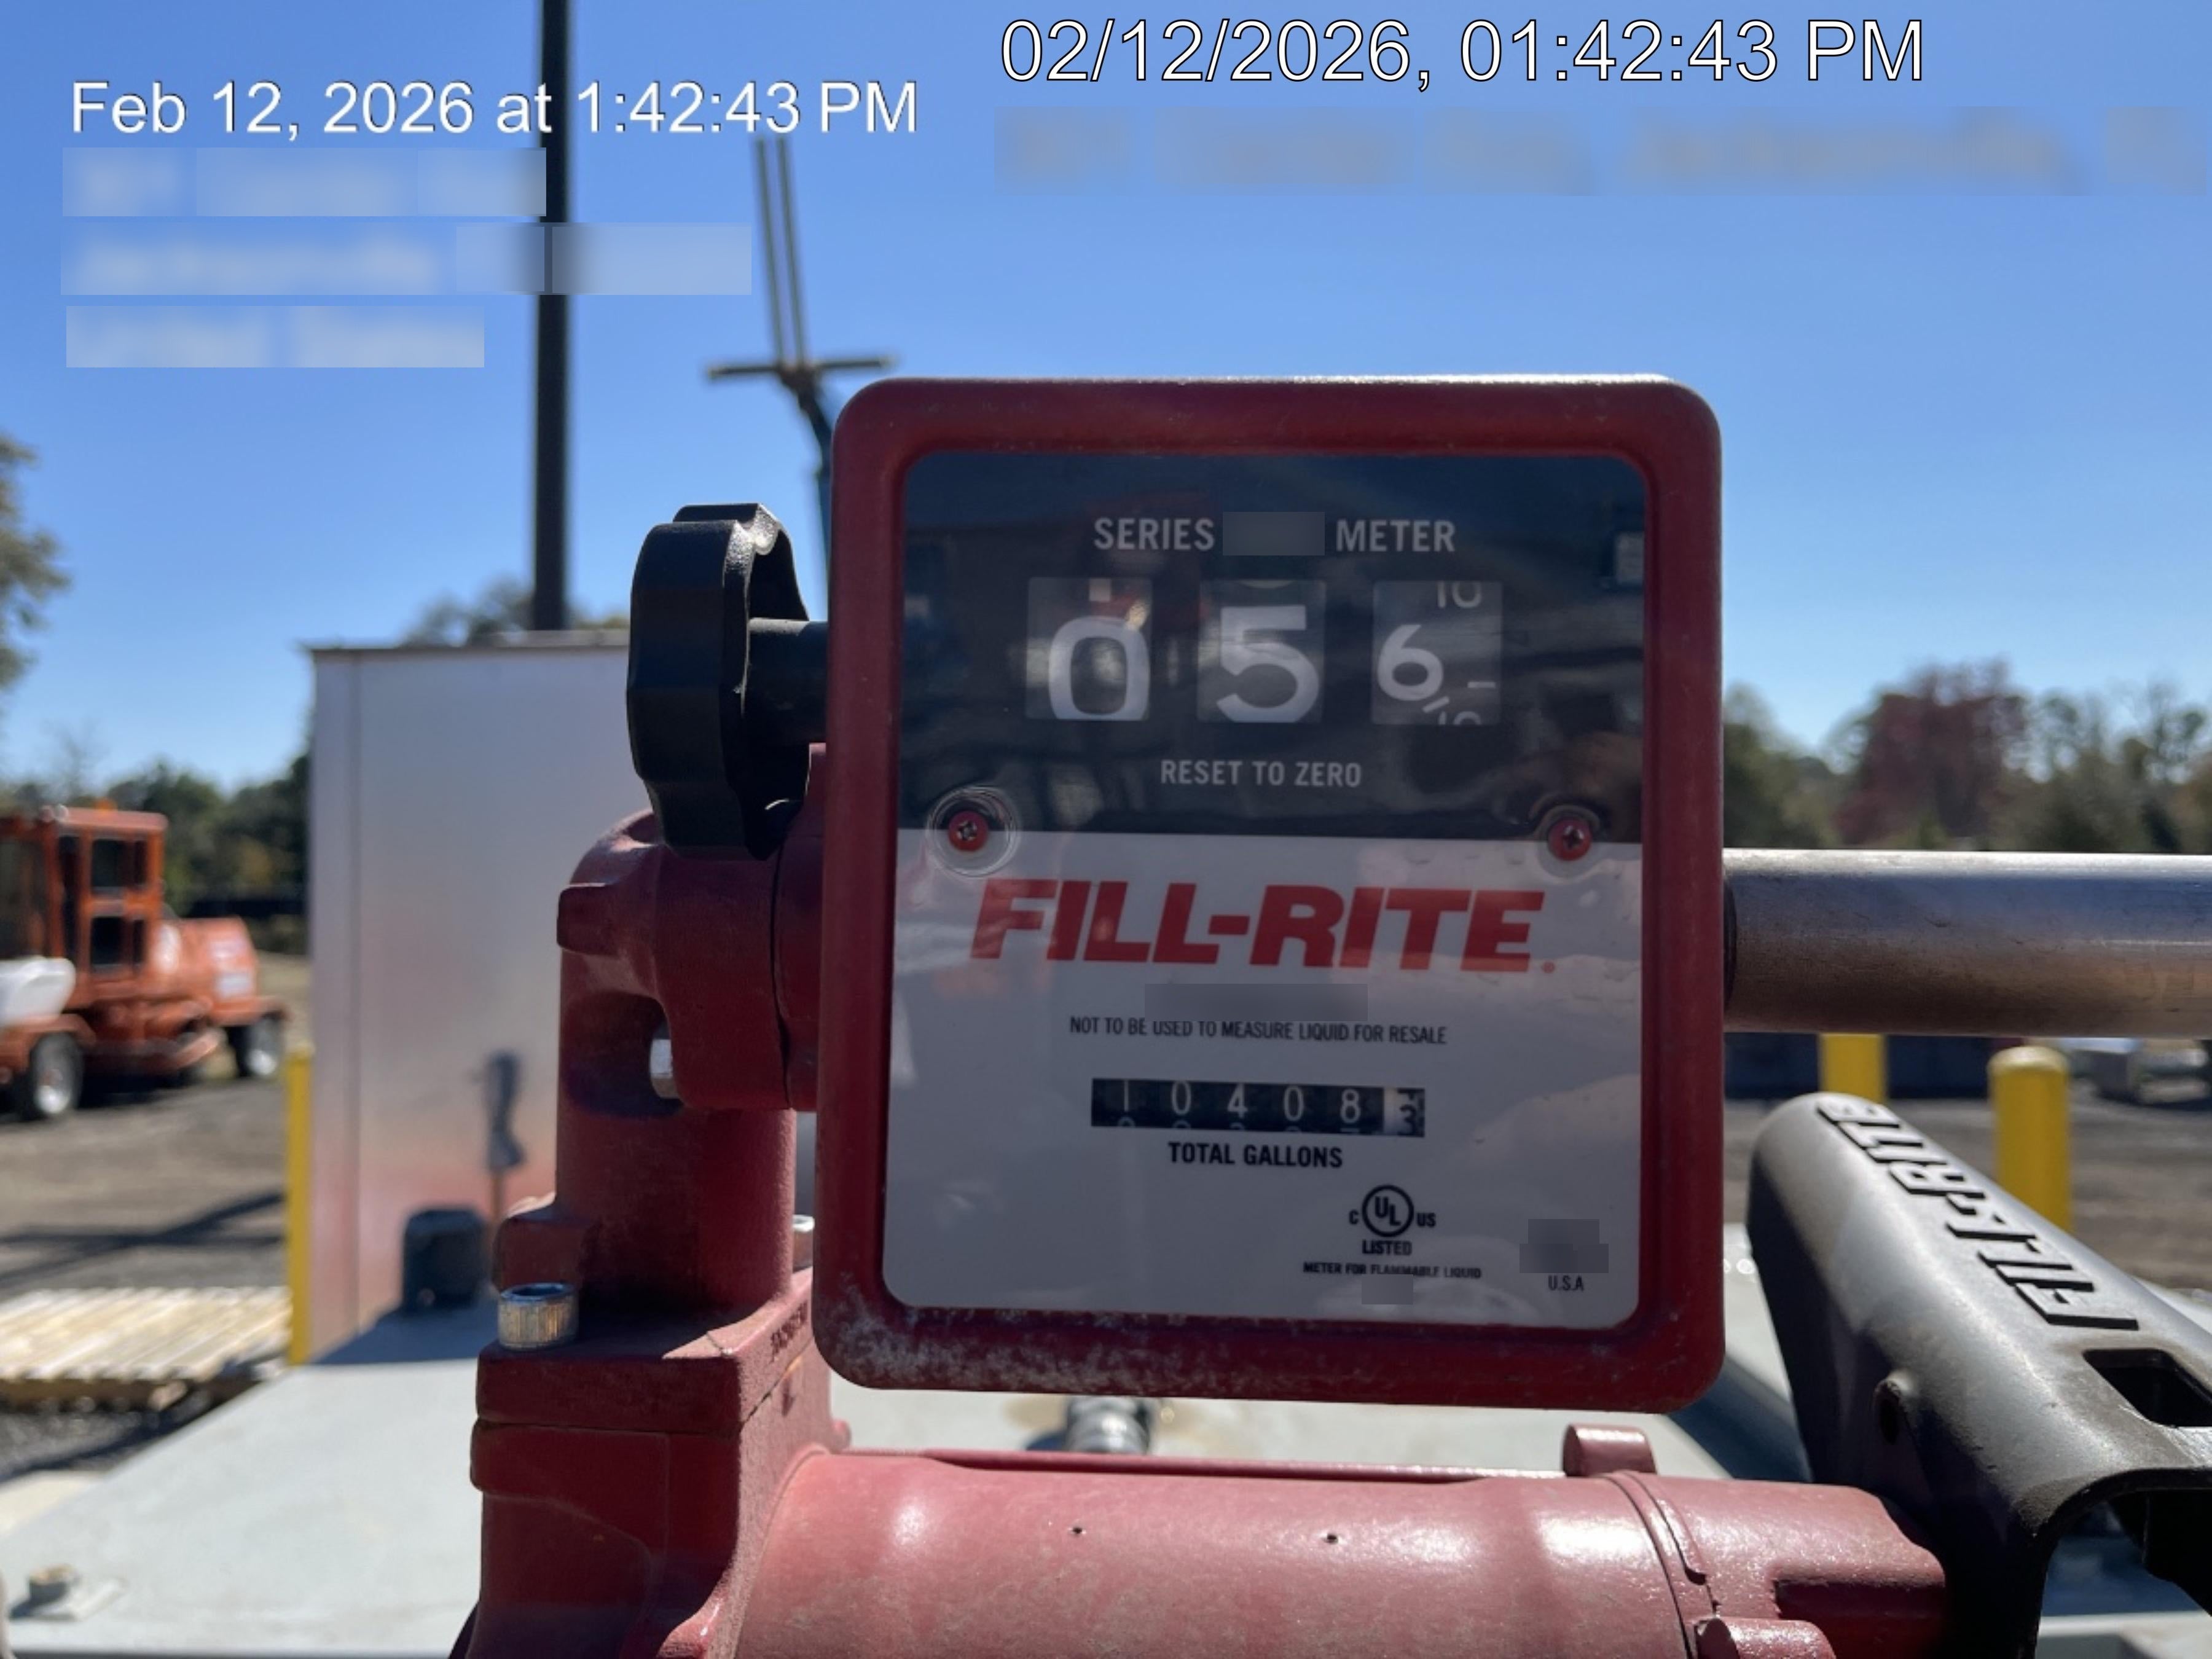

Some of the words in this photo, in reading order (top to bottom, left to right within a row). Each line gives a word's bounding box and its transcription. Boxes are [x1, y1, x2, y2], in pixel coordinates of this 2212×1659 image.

[1093, 518, 1215, 551] SERIES
[1335, 520, 1456, 552] METER
[1160, 760, 1241, 785] RESET
[1252, 761, 1285, 786] TO
[1294, 762, 1362, 786] ZERO
[970, 879, 1545, 973] FILL-RITE
[1070, 1016, 1099, 1034] NOT
[1104, 1017, 1124, 1035] TO
[1128, 1018, 1147, 1036] BE
[1153, 1020, 1193, 1037] USED
[1198, 1021, 1217, 1037] TO
[1221, 1021, 1293, 1040] MEASURE
[1299, 1022, 1349, 1041] LIQUID
[1354, 1024, 1385, 1043] FOR
[1389, 1025, 1447, 1045] RESALE
[1168, 1141, 1236, 1165] TOTAL
[1242, 1144, 1344, 1169] GALLONS
[1416, 1212, 1437, 1228] US
[1813, 1102, 2141, 1332] FILL-RITE
[1362, 1239, 1412, 1255] LISTED
[1303, 1261, 1342, 1274] METER
[1346, 1263, 1367, 1274] FOR
[1371, 1263, 1440, 1278] FLAMMABLE
[1443, 1267, 1482, 1279] LIQUID
[1548, 1274, 1584, 1291] U.S.A
